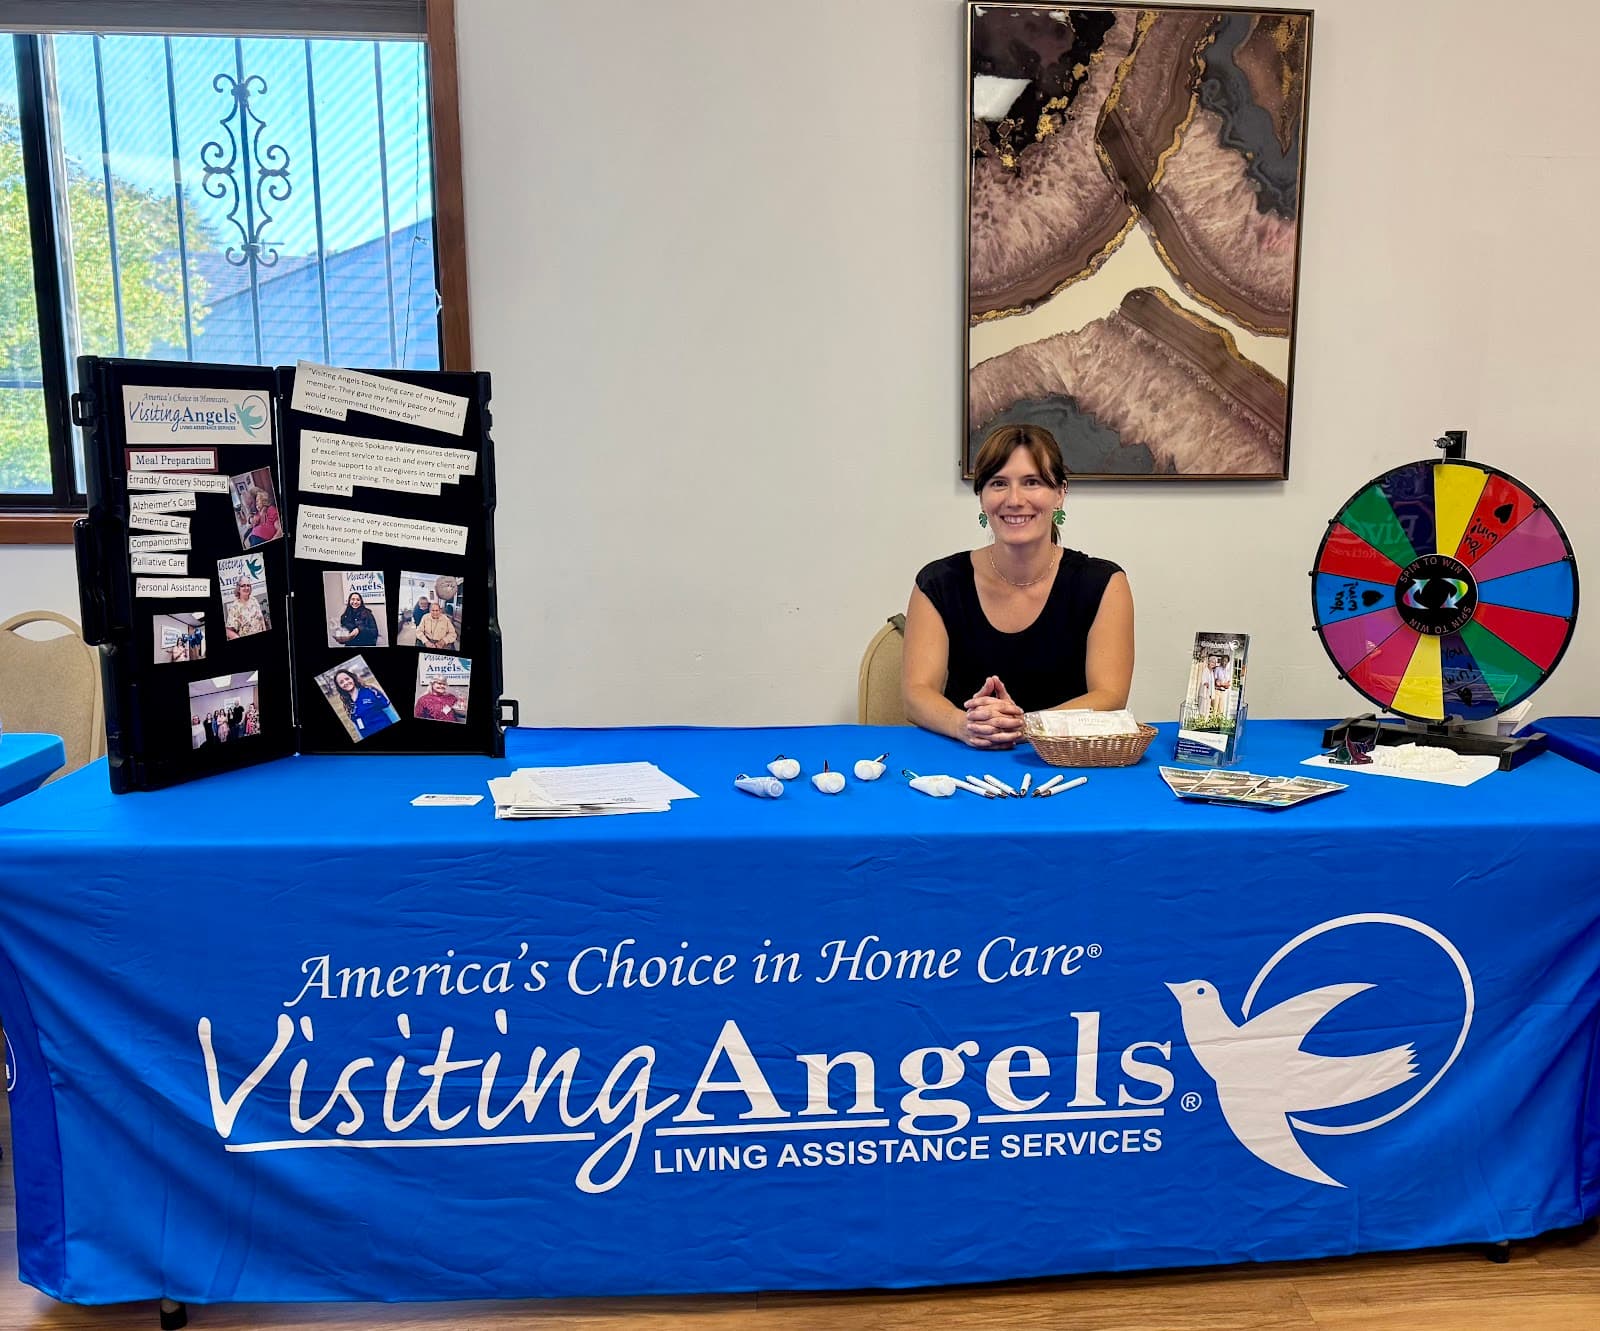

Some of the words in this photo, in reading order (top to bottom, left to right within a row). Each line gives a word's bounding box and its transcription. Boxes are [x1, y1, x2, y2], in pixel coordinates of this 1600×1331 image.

[337, 374, 360, 384] Angels
[361, 380, 377, 388] took
[379, 383, 398, 394] loving
[400, 389, 415, 397] care
[424, 395, 435, 403] my
[436, 396, 457, 408] family
[338, 385, 356, 396] They
[356, 390, 373, 399] gave
[373, 394, 384, 403] my
[385, 396, 406, 408] family
[407, 402, 428, 412] peace
[305, 390, 326, 400] would
[327, 395, 368, 409] recommend
[369, 404, 387, 414] them
[388, 409, 401, 417] any
[129, 401, 183, 432] Visiting
[182, 406, 237, 425] Angels
[320, 448, 350, 457] excellent
[351, 452, 375, 460] service
[416, 460, 436, 468] every
[436, 460, 455, 469] client
[341, 439, 364, 448] Angels
[364, 442, 394, 451] Spokane
[394, 445, 415, 455] Valley
[416, 448, 442, 457] ensures
[443, 451, 471, 460] delivery
[136, 454, 158, 465] Meal
[161, 454, 211, 467] Preparation
[310, 468, 337, 478] logistics
[338, 472, 352, 480] and
[382, 476, 394, 484] The
[396, 478, 411, 486] best
[338, 462, 364, 470] support
[374, 464, 383, 472] all
[383, 466, 418, 476] caregivers
[426, 471, 446, 479] terms
[128, 474, 160, 486] Errands/
[162, 476, 192, 488] Grocery
[192, 477, 226, 490] Shopping
[132, 498, 177, 511] Alzheimer's
[178, 498, 195, 507] Care
[131, 514, 169, 527] Dementia
[170, 519, 188, 529] Care
[326, 514, 351, 522] Service
[352, 517, 365, 525] and
[366, 519, 381, 527] very
[438, 526, 464, 536] Visiting
[131, 537, 190, 549] Companionship
[302, 522, 325, 531] Angels
[326, 524, 344, 532] have
[344, 527, 362, 535] some
[401, 533, 421, 541] Home
[422, 535, 458, 546] Healthcare
[302, 534, 329, 542] workers
[132, 556, 167, 566] Palliative
[168, 558, 186, 568] Care
[1400, 561, 1421, 583] SPIN
[1423, 556, 1438, 566] TO
[1442, 558, 1463, 574] WIN
[137, 582, 170, 592] Personal
[170, 582, 208, 592] Assistance
[350, 582, 382, 592] Angels
[1329, 590, 1345, 614] You
[1408, 618, 1429, 633] WIN
[1451, 606, 1472, 629] SPIN
[1434, 625, 1450, 634] TO
[427, 664, 462, 673] Angels
[283, 942, 549, 1007] America's
[567, 938, 736, 996] Choice
[752, 939, 802, 986] in
[816, 935, 961, 984] Home
[198, 1008, 680, 1194] Visiting
[672, 1011, 1175, 1136] Angels
[655, 1145, 768, 1174] LIVING
[777, 1136, 990, 1168] ASSISTANCE
[1000, 1128, 1163, 1159] SERVICES
